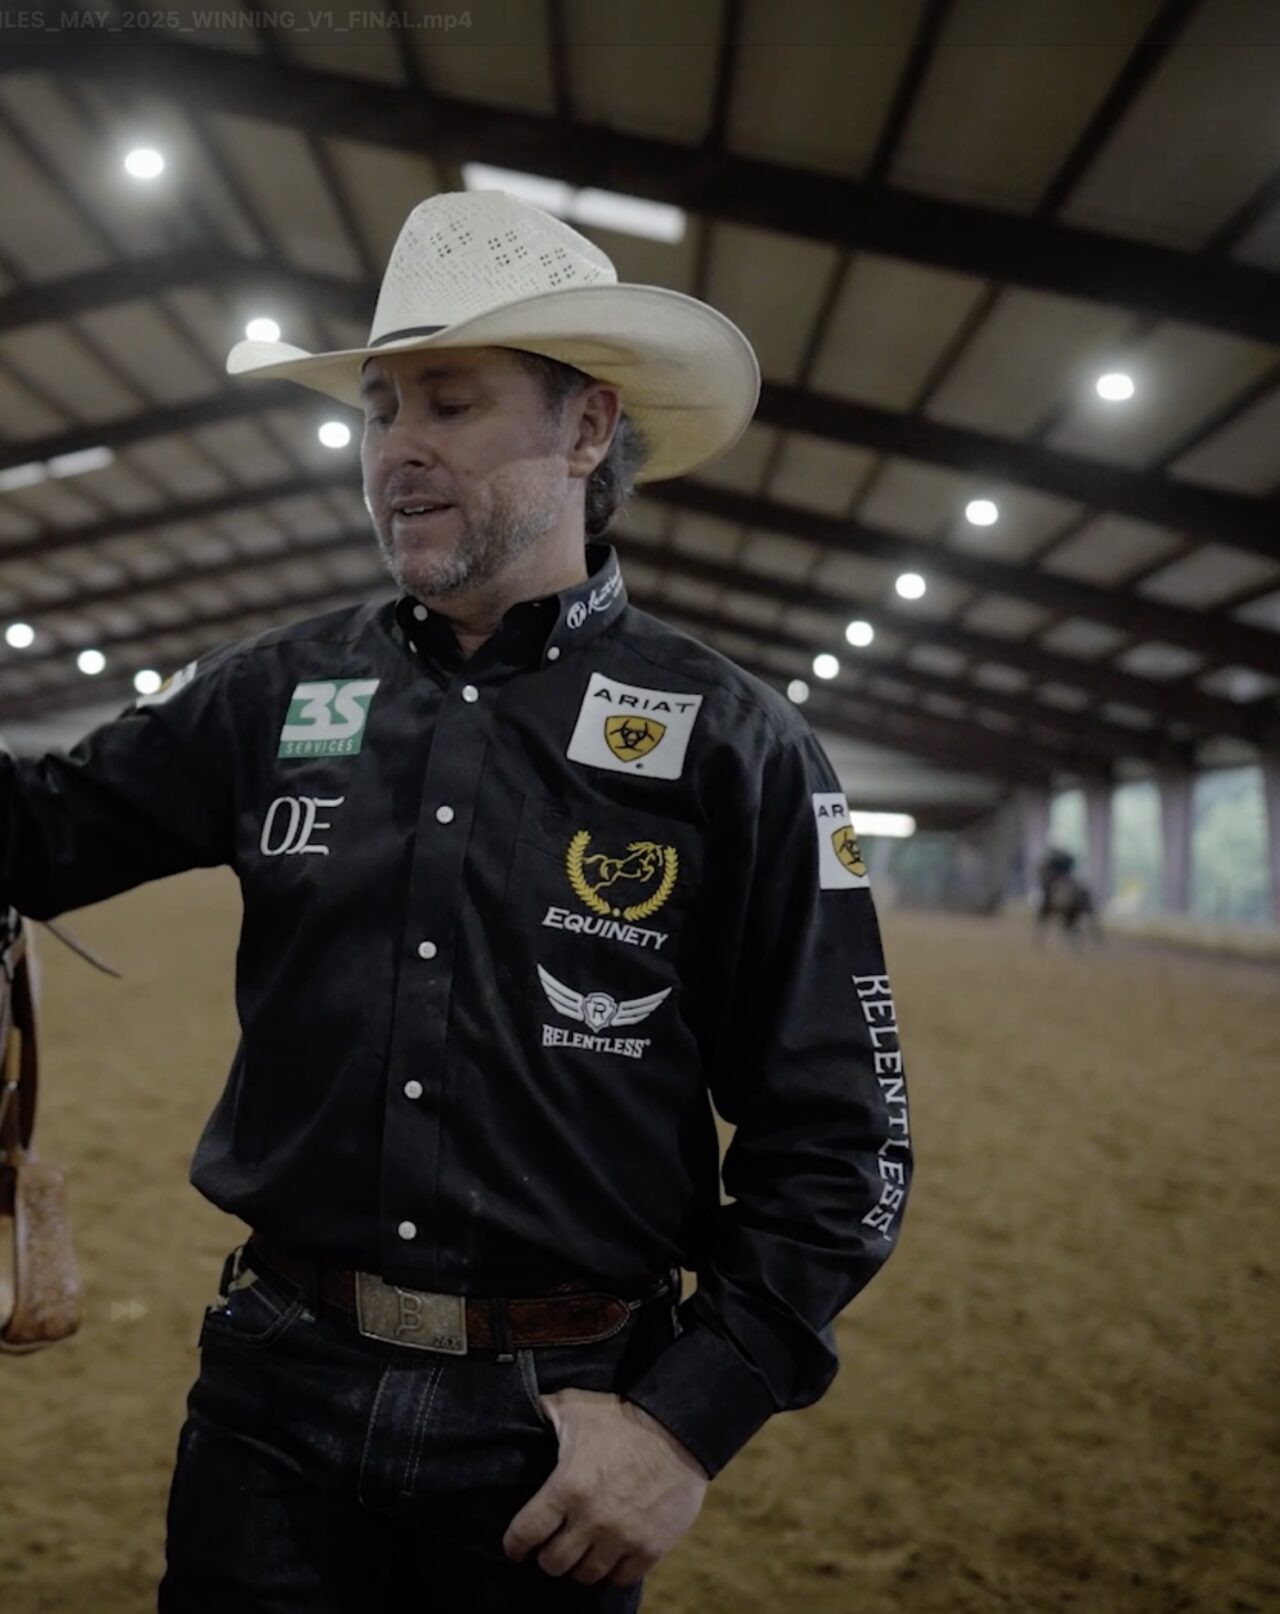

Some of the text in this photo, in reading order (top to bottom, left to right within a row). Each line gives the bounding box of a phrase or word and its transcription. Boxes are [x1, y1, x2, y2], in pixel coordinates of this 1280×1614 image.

[280, 679, 380, 741] 3S
[593, 688, 696, 713] ARIAT
[285, 739, 355, 754] SERVICES
[541, 906, 669, 950] EQUINETY
[592, 1000, 608, 1021] R
[541, 1023, 647, 1059] RELENTLESS
[852, 973, 910, 1235] RELENTLESS
